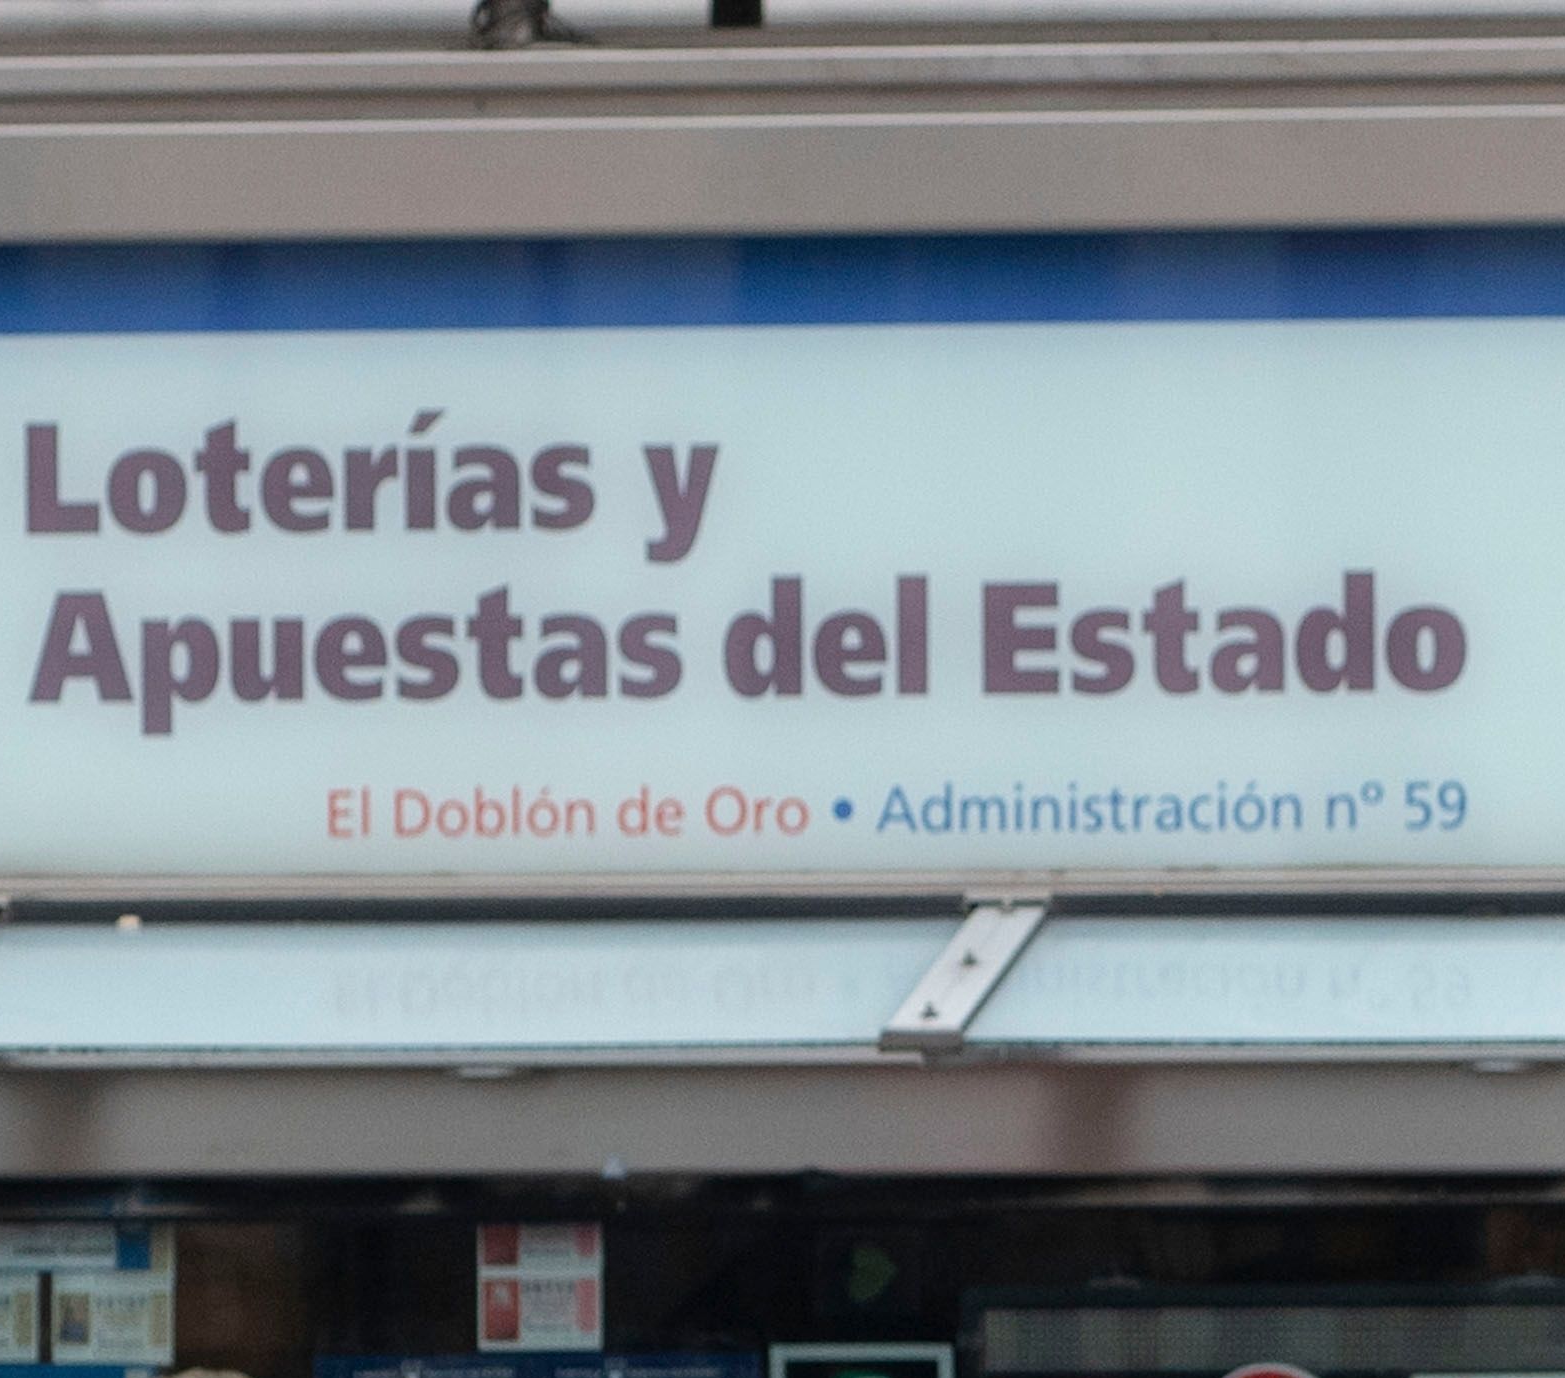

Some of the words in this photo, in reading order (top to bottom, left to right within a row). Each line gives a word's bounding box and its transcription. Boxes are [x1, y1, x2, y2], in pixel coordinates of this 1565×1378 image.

[25, 410, 596, 536] Loterías
[643, 444, 719, 565] y
[28, 585, 683, 736] Apuestas
[723, 575, 929, 700] del
[981, 570, 1468, 697] Estado
[327, 788, 371, 839] El
[393, 784, 596, 839] Doblón
[617, 786, 685, 838] de
[705, 786, 810, 839] Oro
[876, 782, 1303, 836] Administración
[1325, 781, 1385, 832] nº
[1405, 780, 1468, 832] 59
